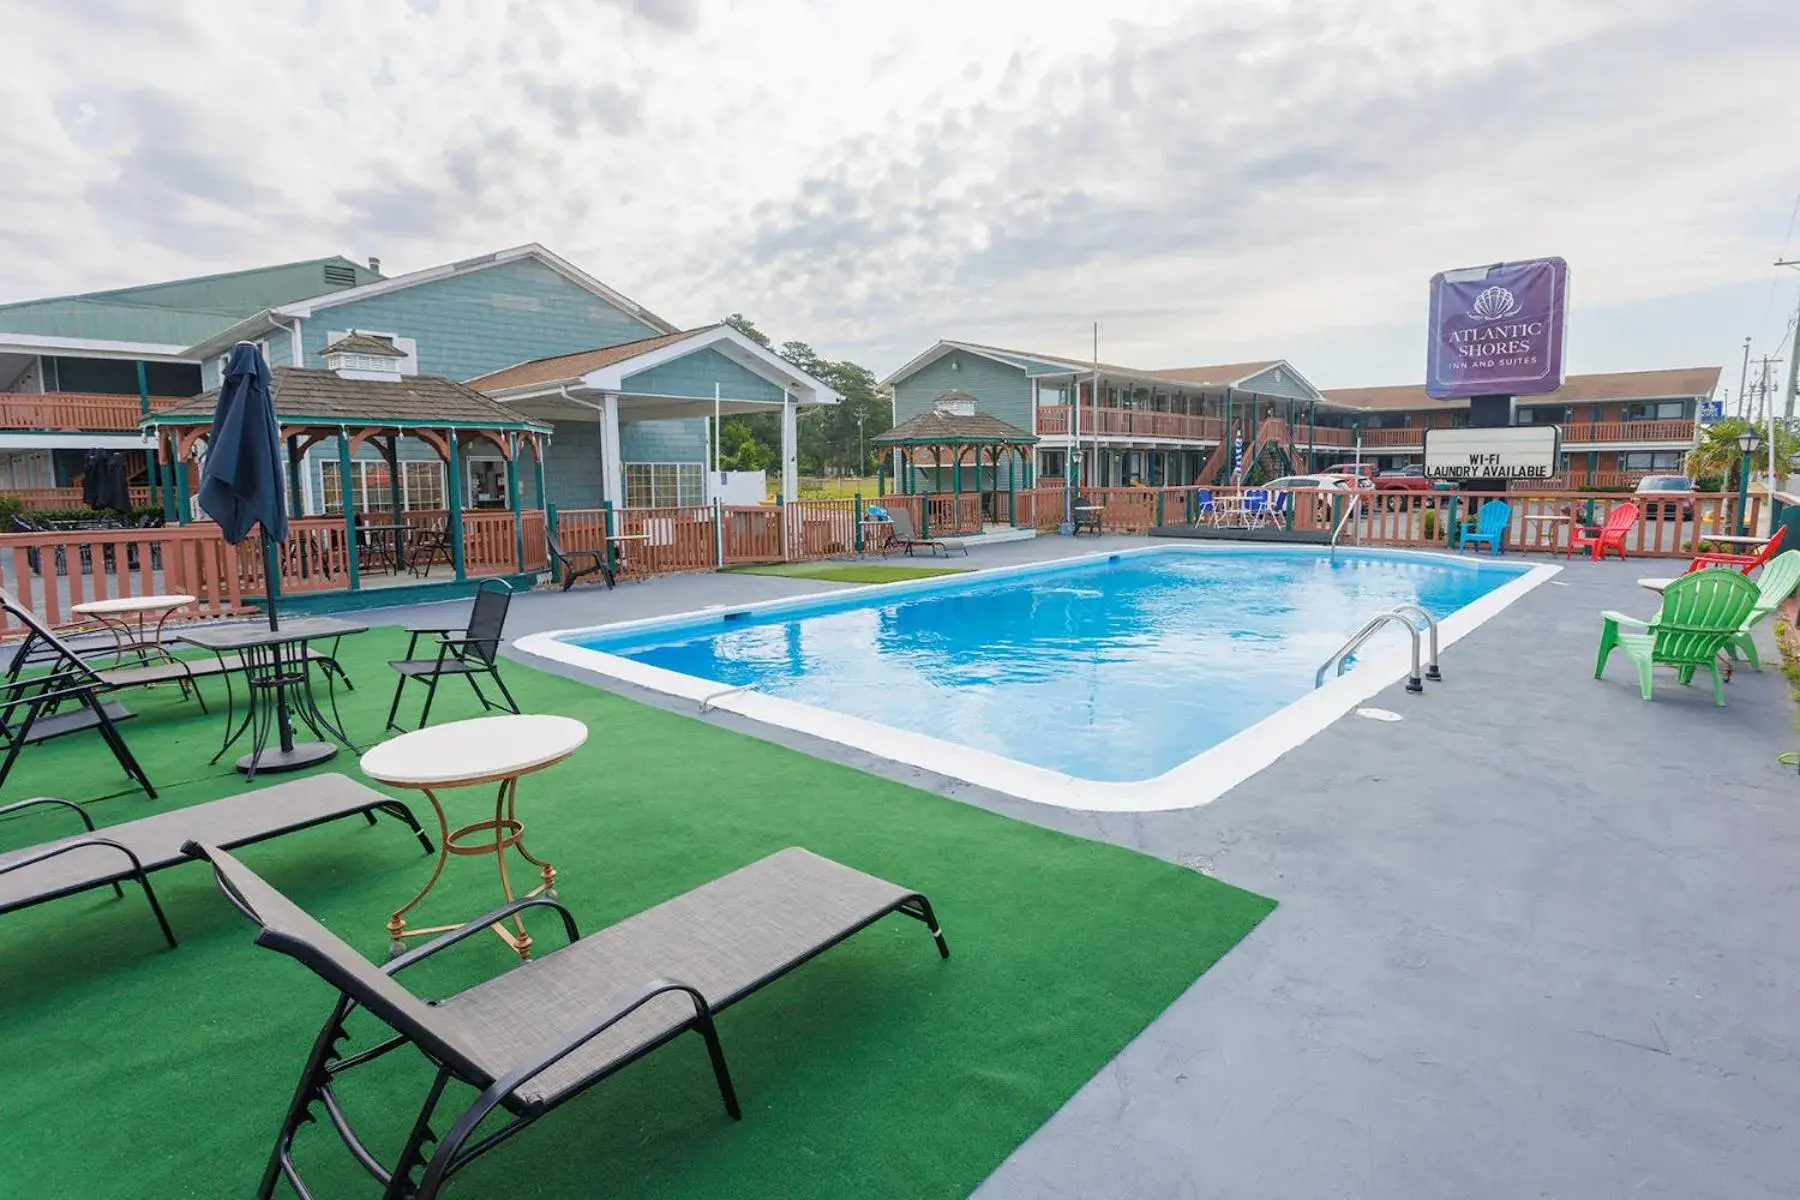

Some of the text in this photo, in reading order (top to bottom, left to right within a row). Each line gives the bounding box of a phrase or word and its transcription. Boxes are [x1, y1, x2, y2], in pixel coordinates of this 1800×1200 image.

[1449, 322, 1542, 343] ATLANTIC
[1458, 340, 1530, 357] SHORES
[1449, 356, 1537, 370] INN AND SUITES
[1469, 454, 1500, 465] WI-FI
[1427, 466, 1547, 477] LAUNDRY AVAILABLE
